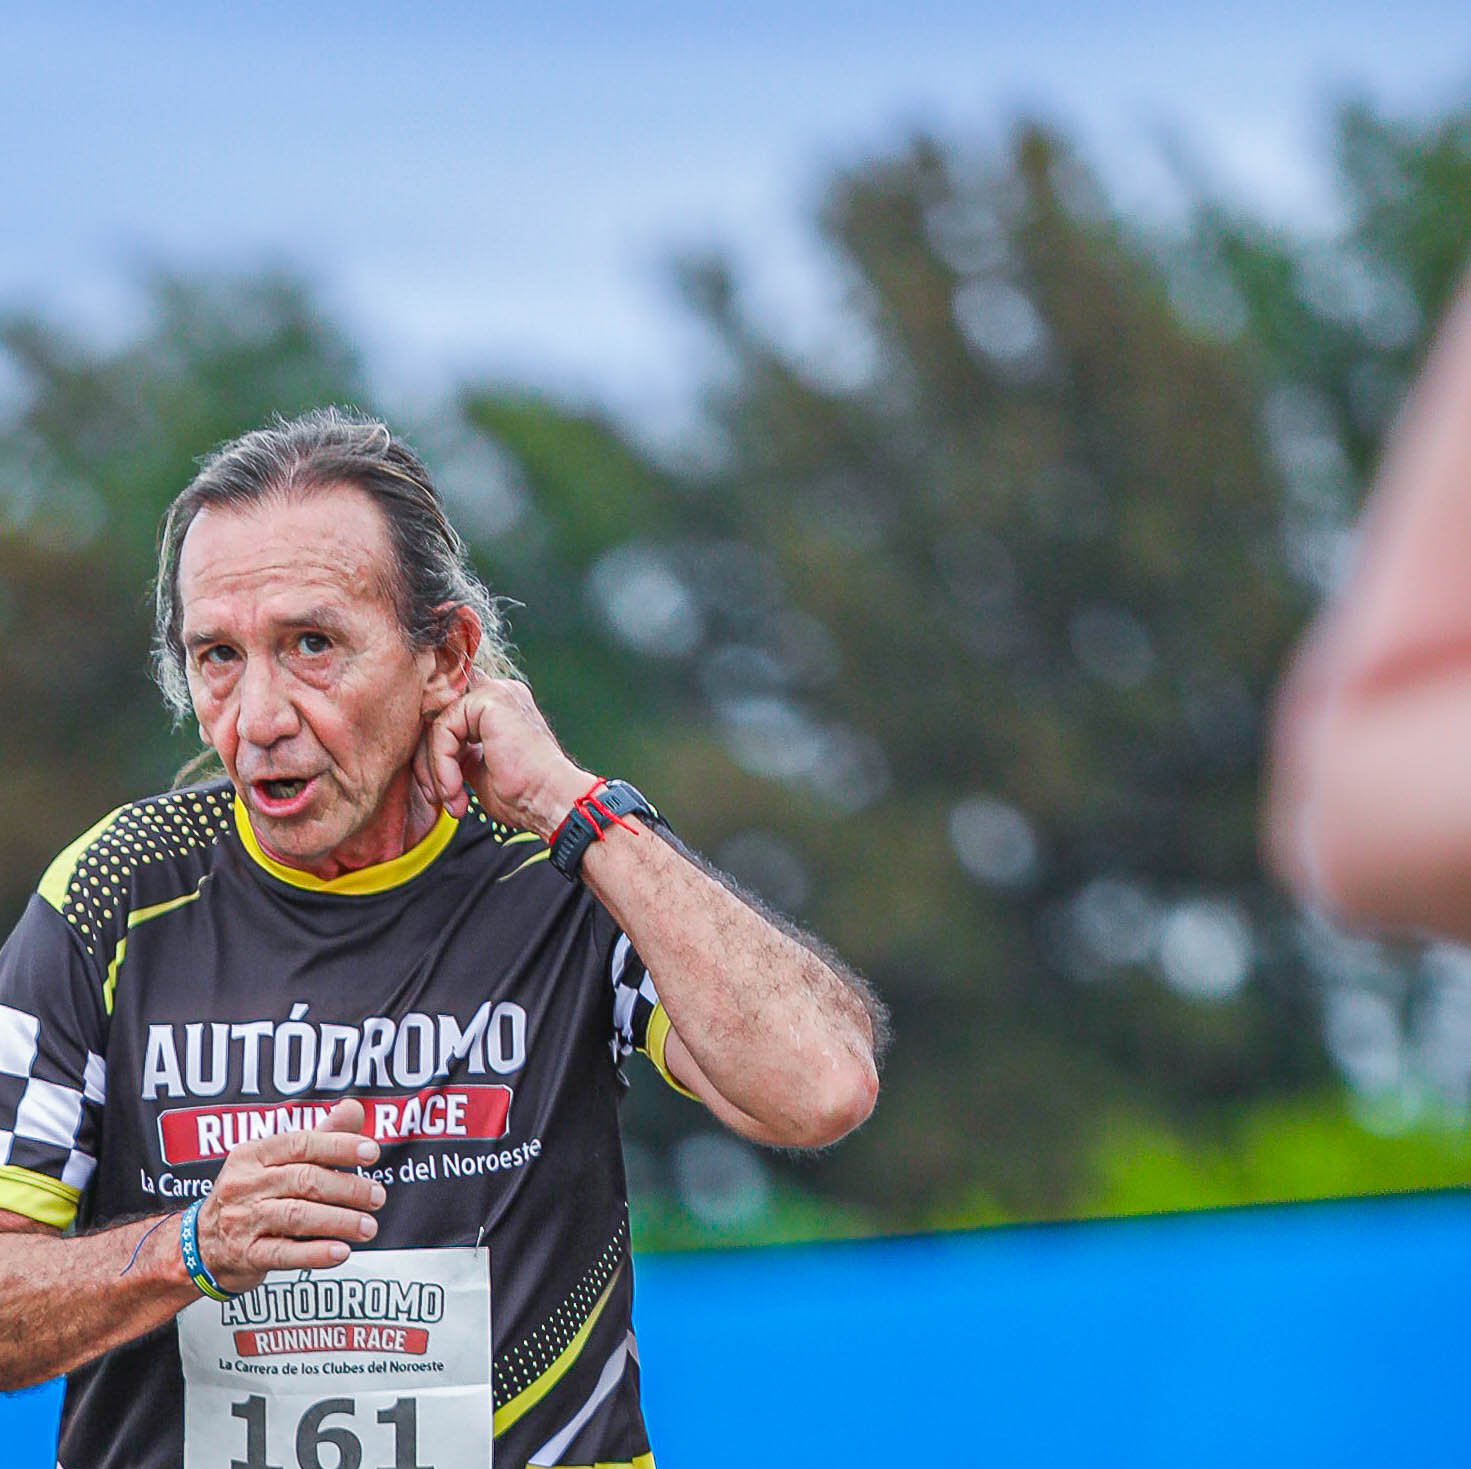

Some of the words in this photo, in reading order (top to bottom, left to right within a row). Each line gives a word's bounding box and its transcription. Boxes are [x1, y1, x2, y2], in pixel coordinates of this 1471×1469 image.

[141, 1001, 528, 1100] AUTÓDROMO
[373, 1094, 469, 1140] RACE
[158, 1173, 214, 1198] Carre
[399, 1155, 438, 1184] del
[442, 1138, 543, 1179] Noroeste
[221, 1269, 445, 1325] AUTÓDROMO
[254, 1326, 346, 1355] RUNNING
[353, 1326, 407, 1352] RACE
[219, 1358, 232, 1371] La
[235, 1360, 279, 1375] Carrera
[282, 1362, 298, 1375] de
[301, 1363, 319, 1375] los
[322, 1361, 364, 1375] Clubes
[368, 1361, 386, 1374] del
[389, 1361, 444, 1374] Noroeste
